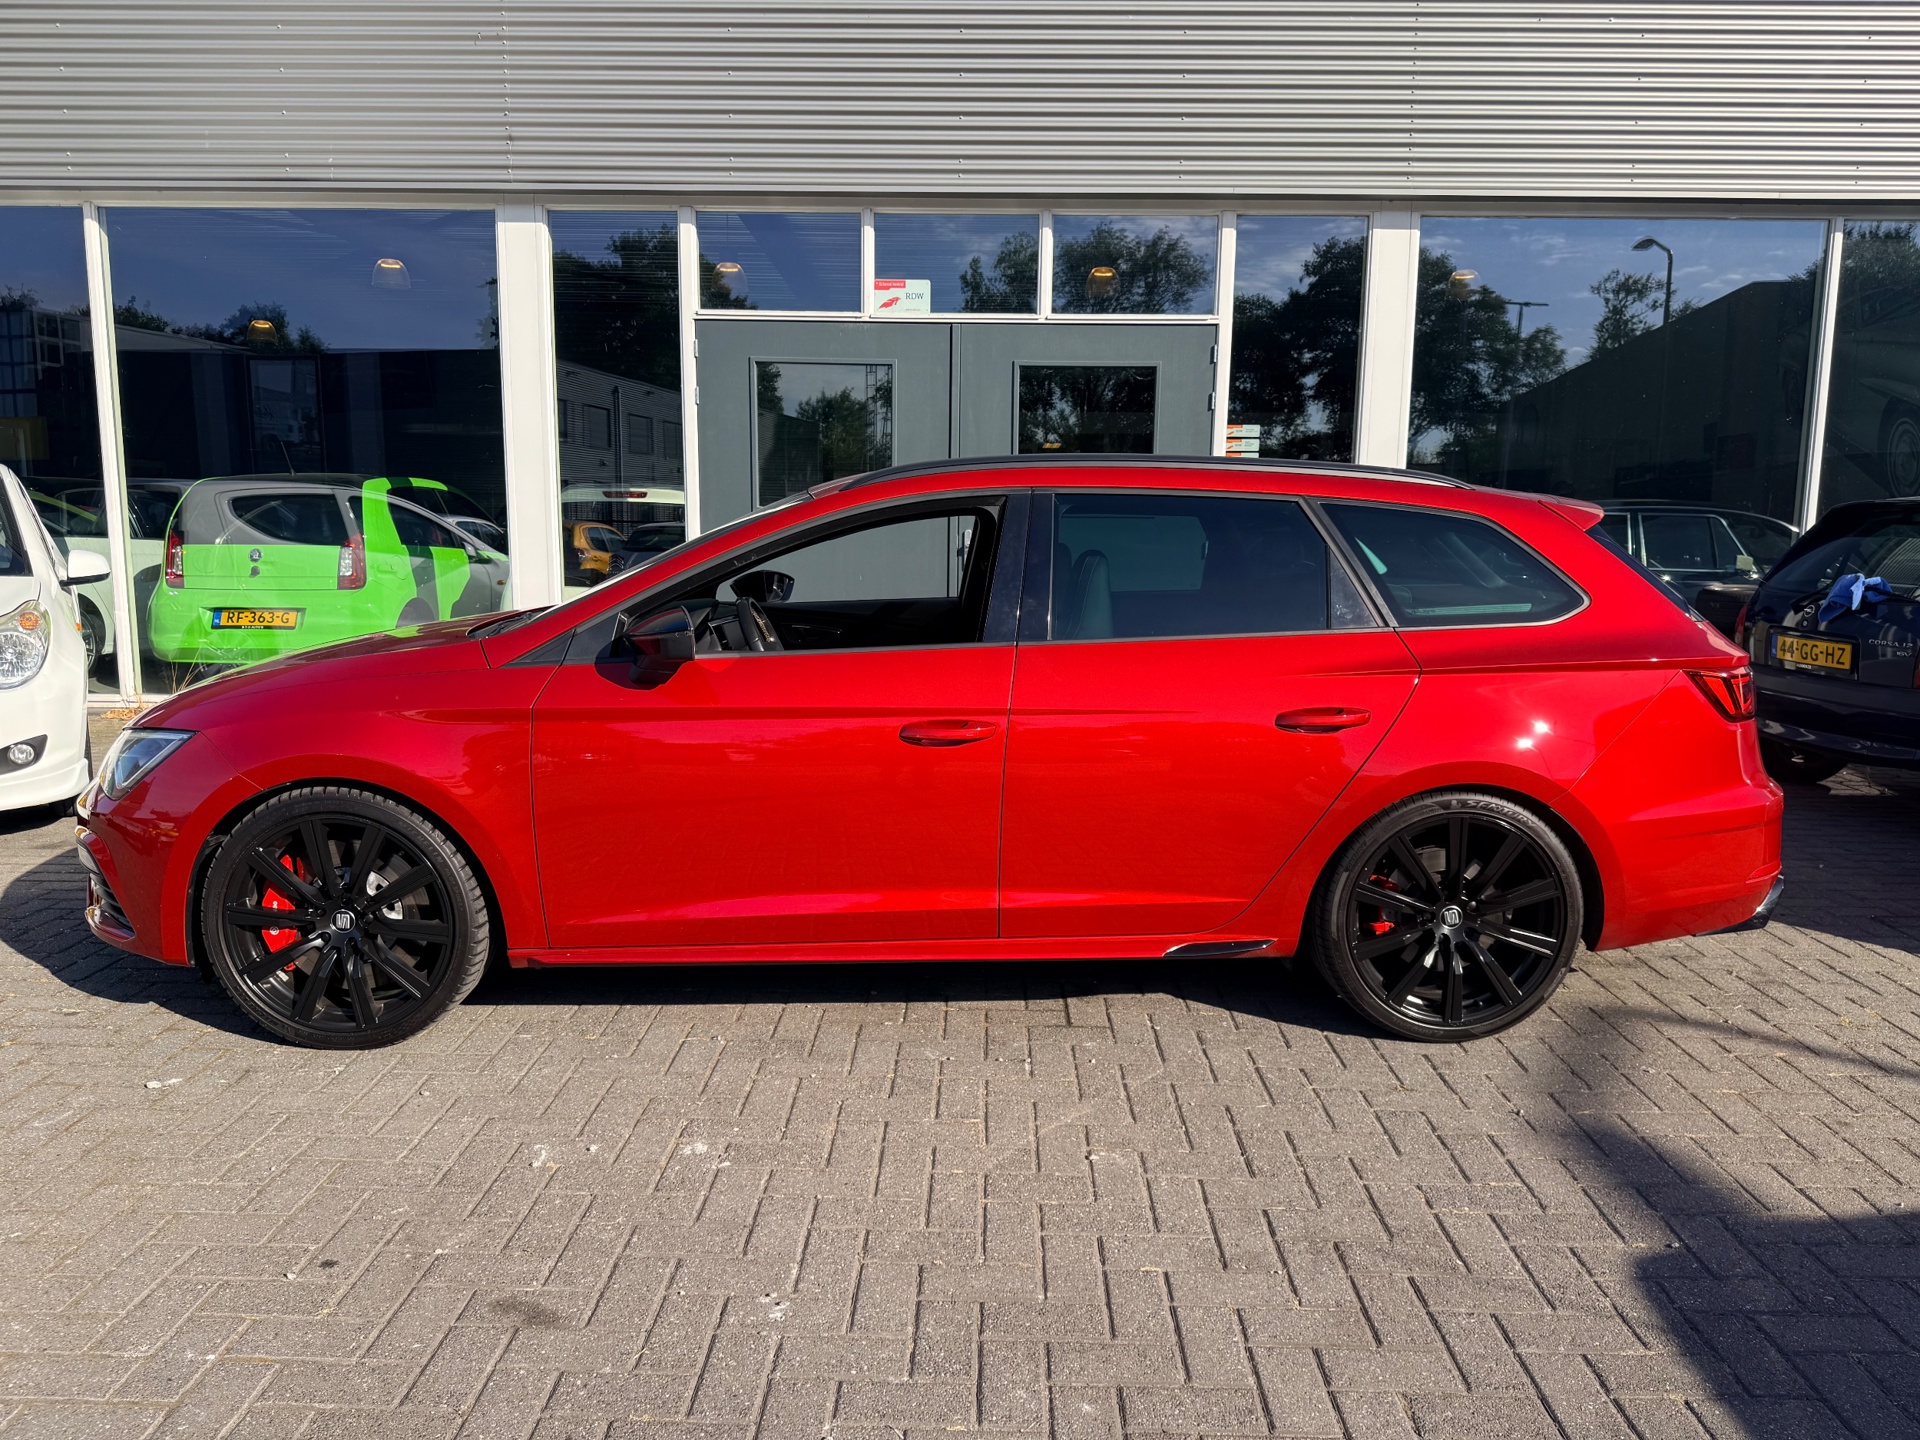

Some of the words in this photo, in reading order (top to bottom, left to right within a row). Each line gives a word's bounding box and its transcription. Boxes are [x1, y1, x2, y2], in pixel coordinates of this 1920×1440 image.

[905, 292, 924, 300] RDW
[226, 611, 290, 624] RF-363-G
[1868, 639, 1900, 647] CORSA
[1779, 639, 1846, 666] 44-GG-HZ
[398, 820, 444, 864] MICHELIN
